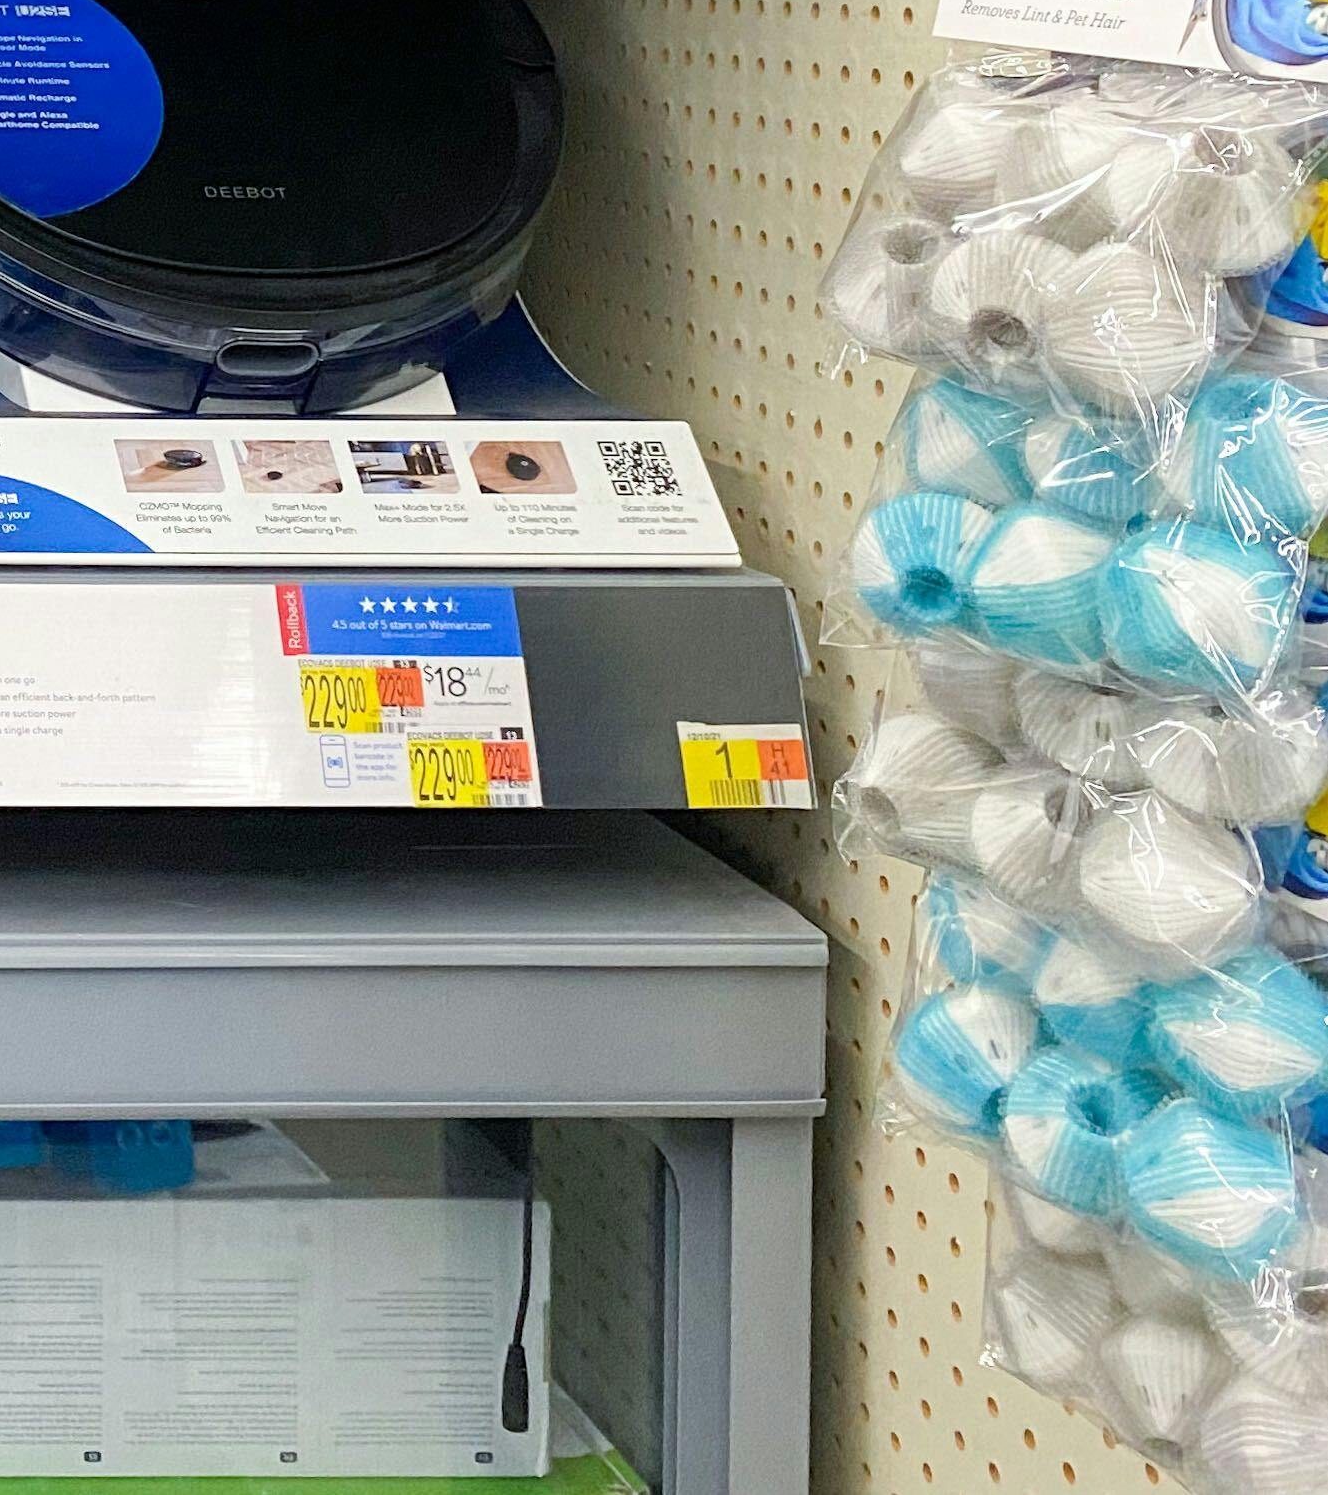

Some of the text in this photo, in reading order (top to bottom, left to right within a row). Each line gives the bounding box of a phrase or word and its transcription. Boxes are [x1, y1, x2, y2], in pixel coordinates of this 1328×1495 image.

[961, 0, 1126, 30] Removes Lint & Pet Hair
[205, 186, 285, 198] DEEBOT
[283, 590, 302, 649] Rollback
[715, 741, 733, 779] 1
